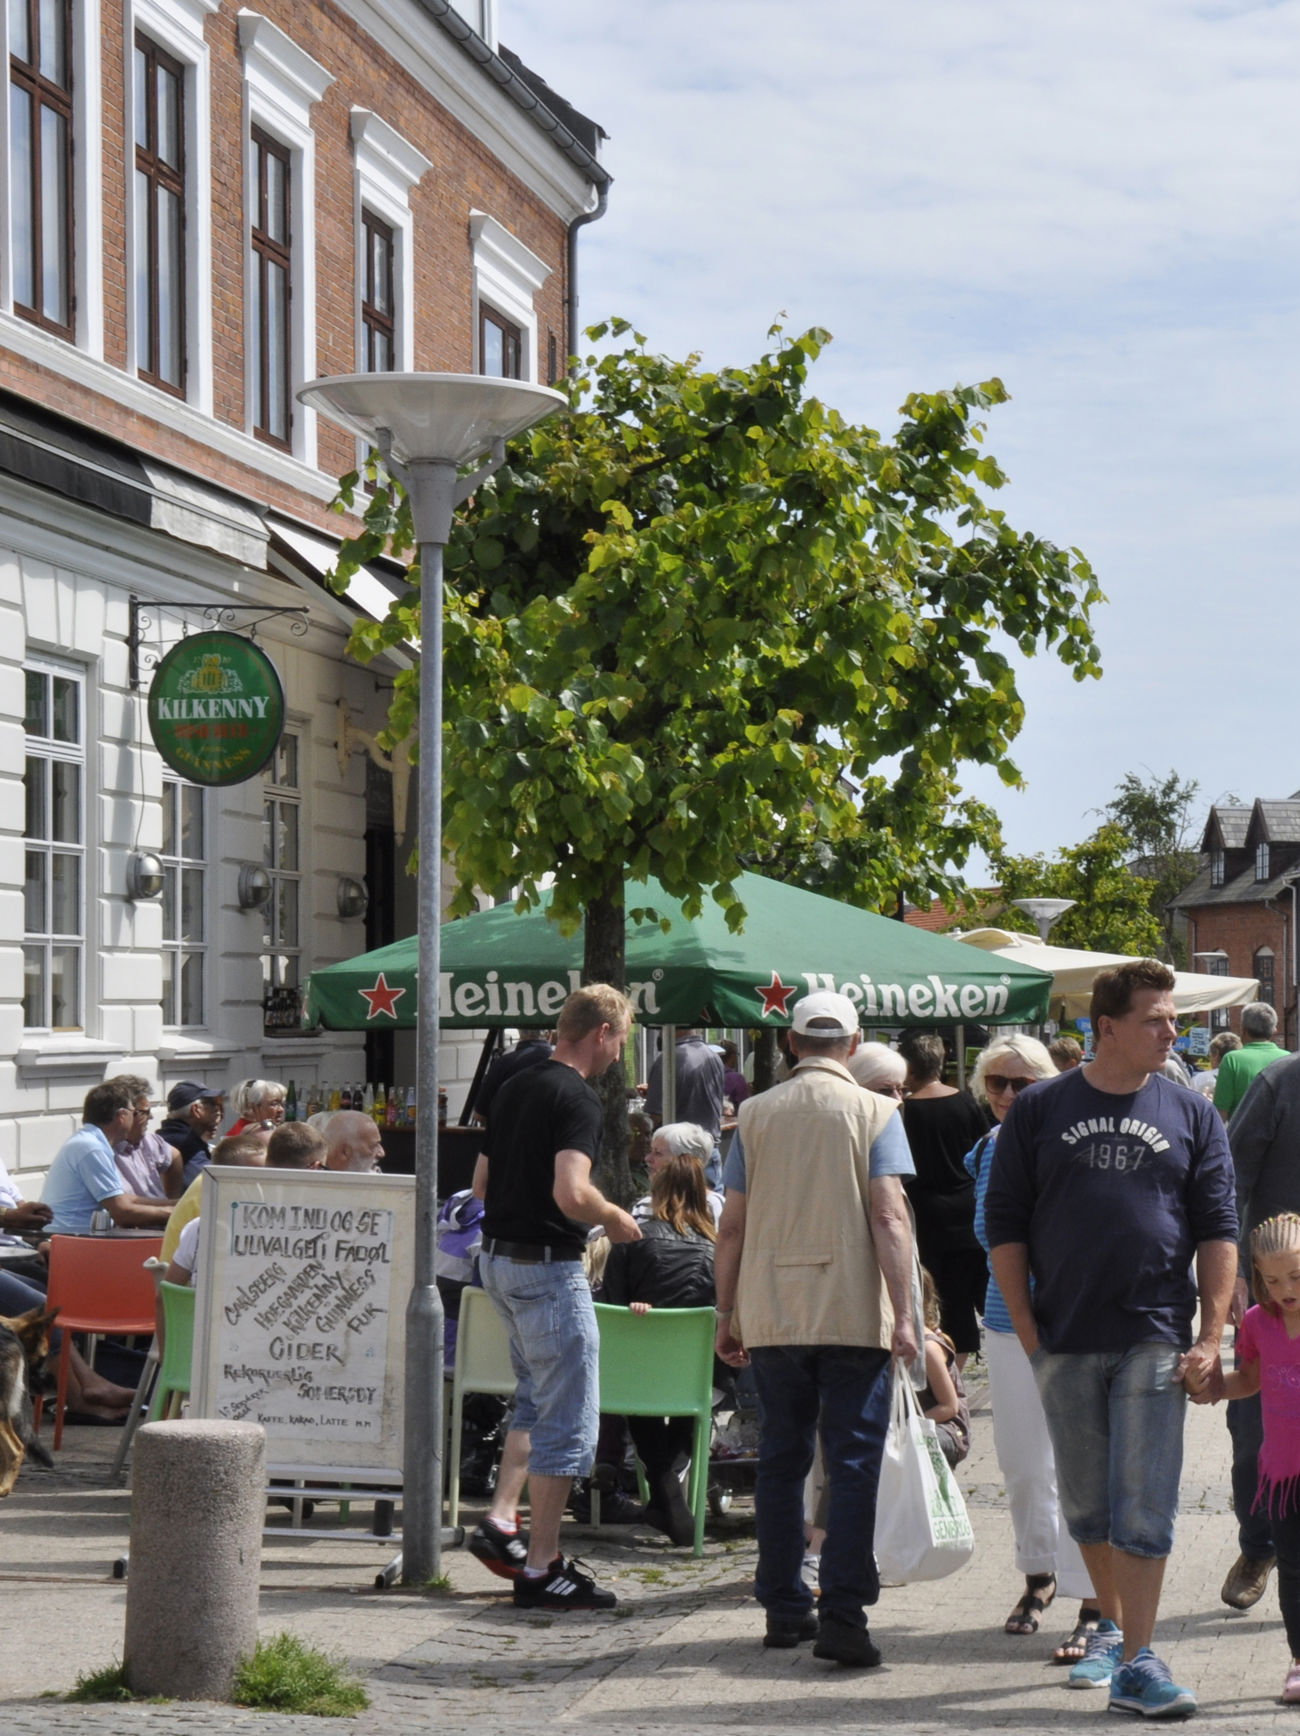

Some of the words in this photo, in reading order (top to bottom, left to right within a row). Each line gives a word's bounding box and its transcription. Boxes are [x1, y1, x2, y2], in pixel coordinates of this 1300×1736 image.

[158, 696, 270, 720] KILKENNY
[1061, 1117, 1115, 1145] SIGNAL
[1089, 1142, 1146, 1170] 1967
[242, 1205, 286, 1230] KOM
[330, 1211, 354, 1232] OG
[355, 1211, 382, 1236] SE
